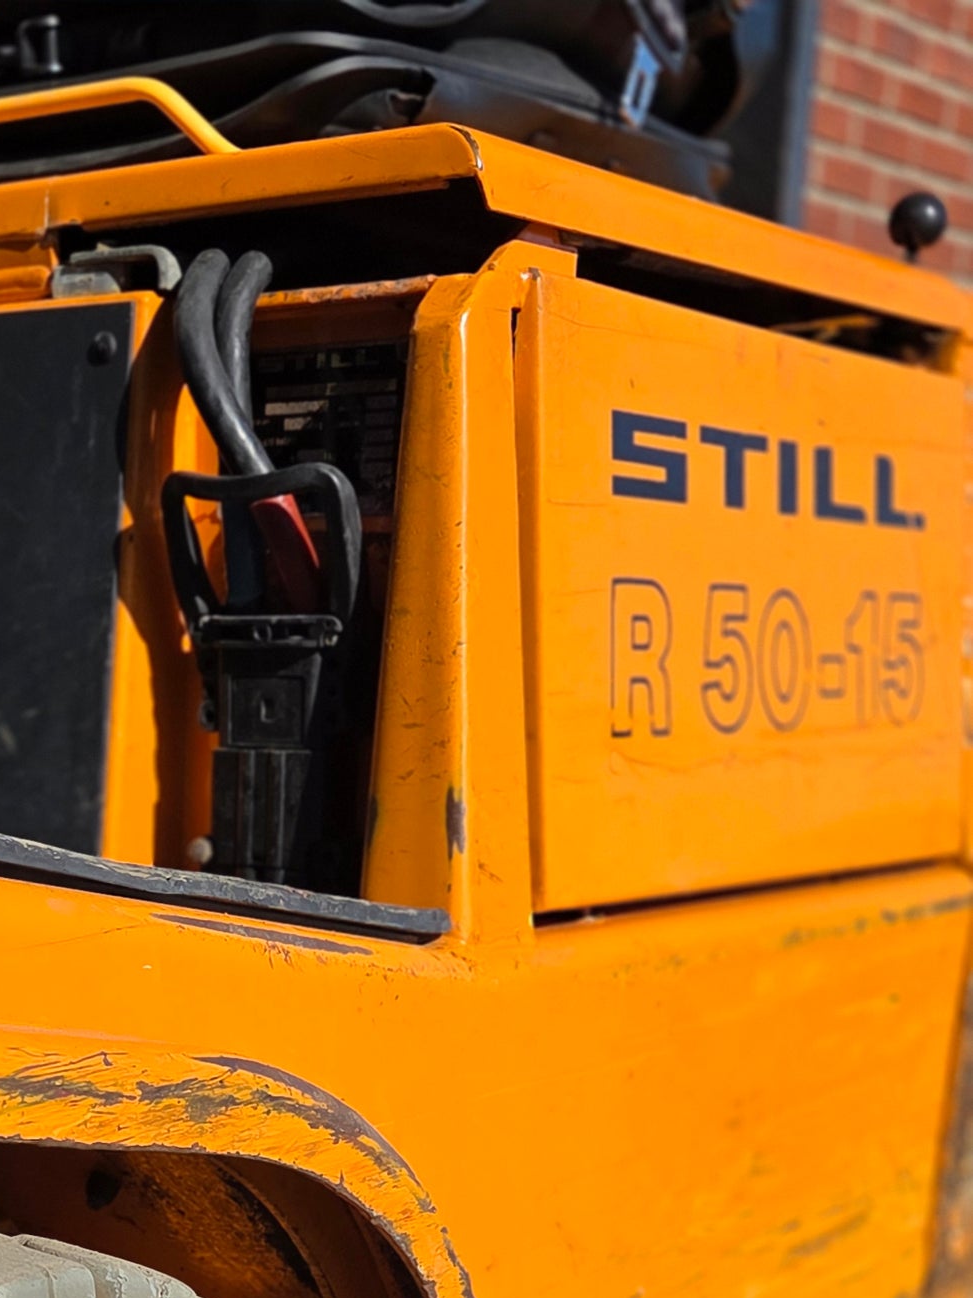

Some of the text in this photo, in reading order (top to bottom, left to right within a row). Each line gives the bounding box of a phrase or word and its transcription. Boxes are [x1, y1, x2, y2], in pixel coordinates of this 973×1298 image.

[612, 409, 926, 531] STILL
[612, 577, 927, 739] R 50-15
